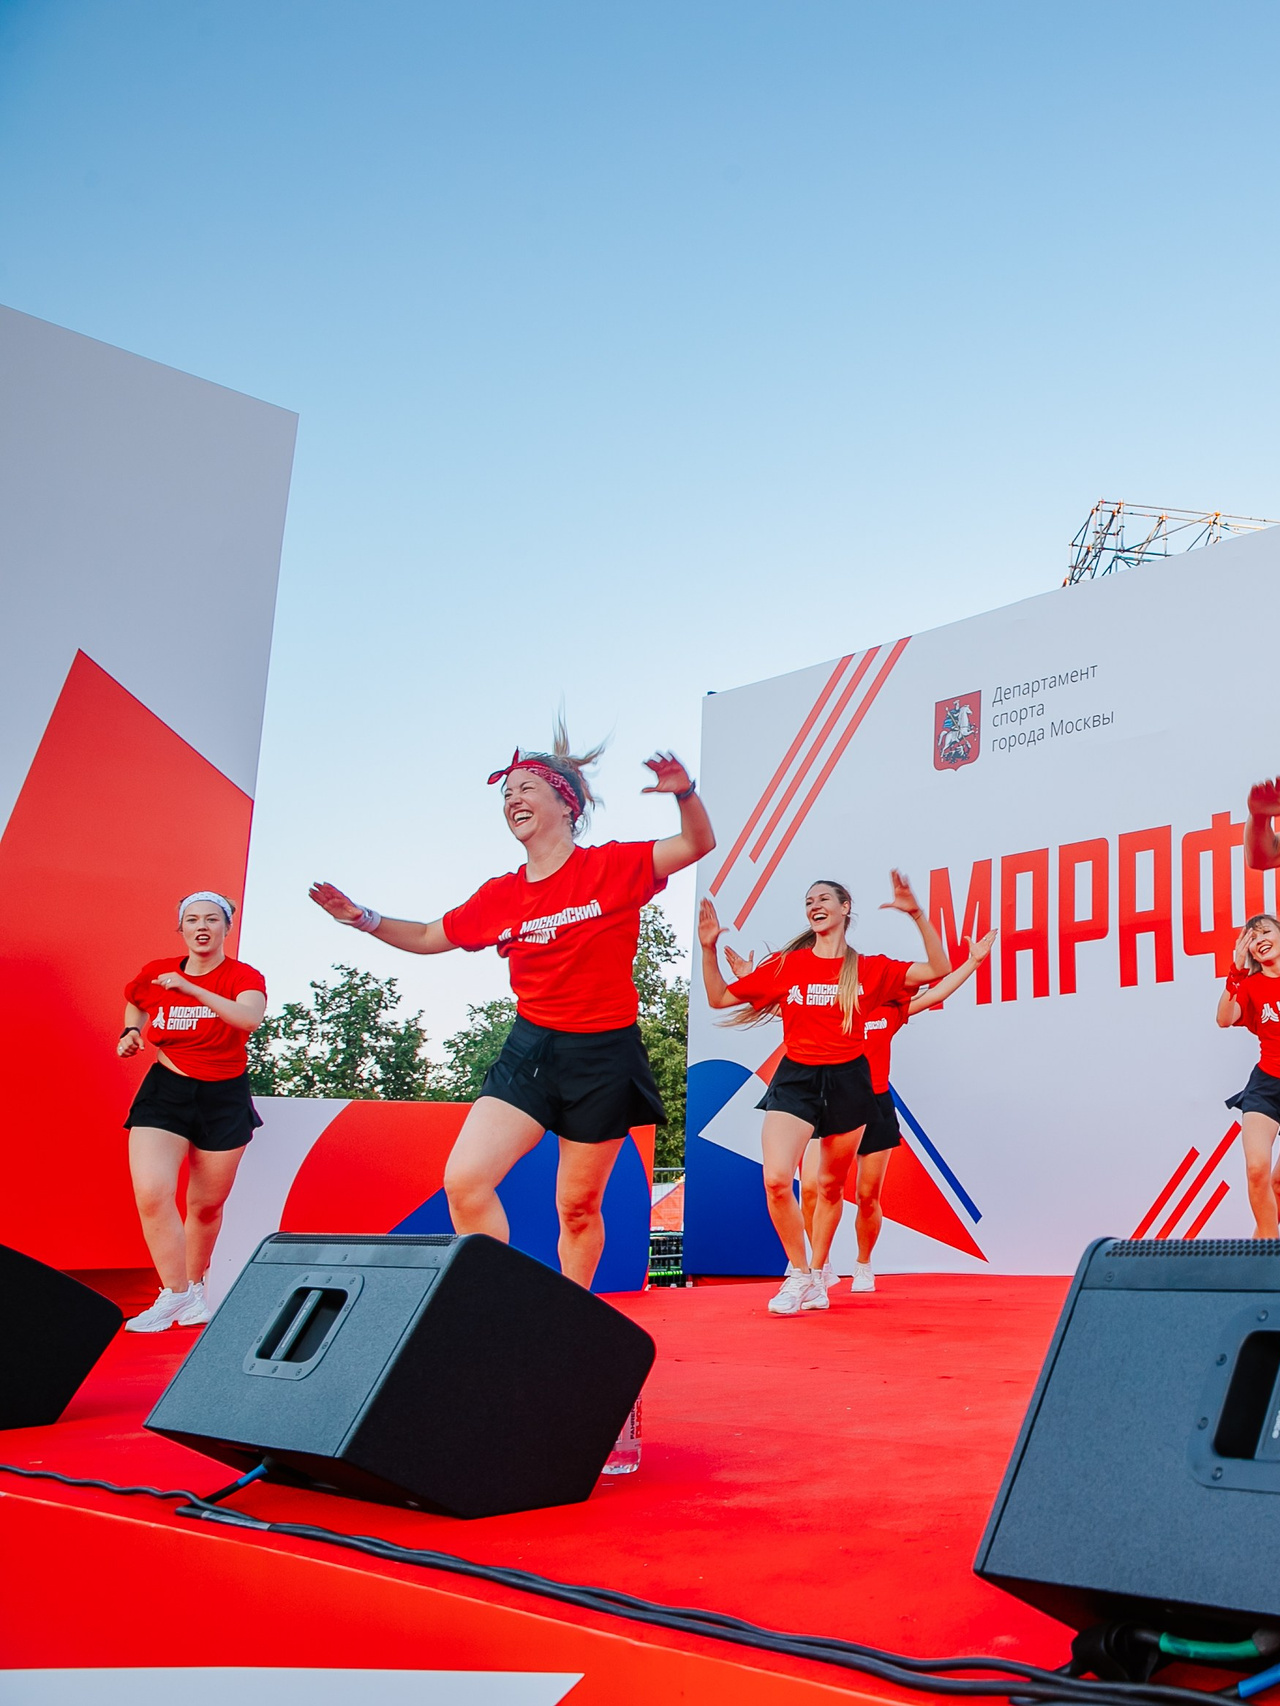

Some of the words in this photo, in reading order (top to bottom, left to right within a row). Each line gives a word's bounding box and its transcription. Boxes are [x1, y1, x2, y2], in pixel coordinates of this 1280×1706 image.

[992, 664, 1098, 707] Департамент
[992, 703, 1045, 726] спорта
[992, 727, 1045, 753] города
[1050, 711, 1114, 738] Москвы
[519, 899, 602, 934] МОСКОВСКИЙ
[806, 994, 836, 1006] СПОРТ
[166, 1018, 199, 1030] СПОРТ
